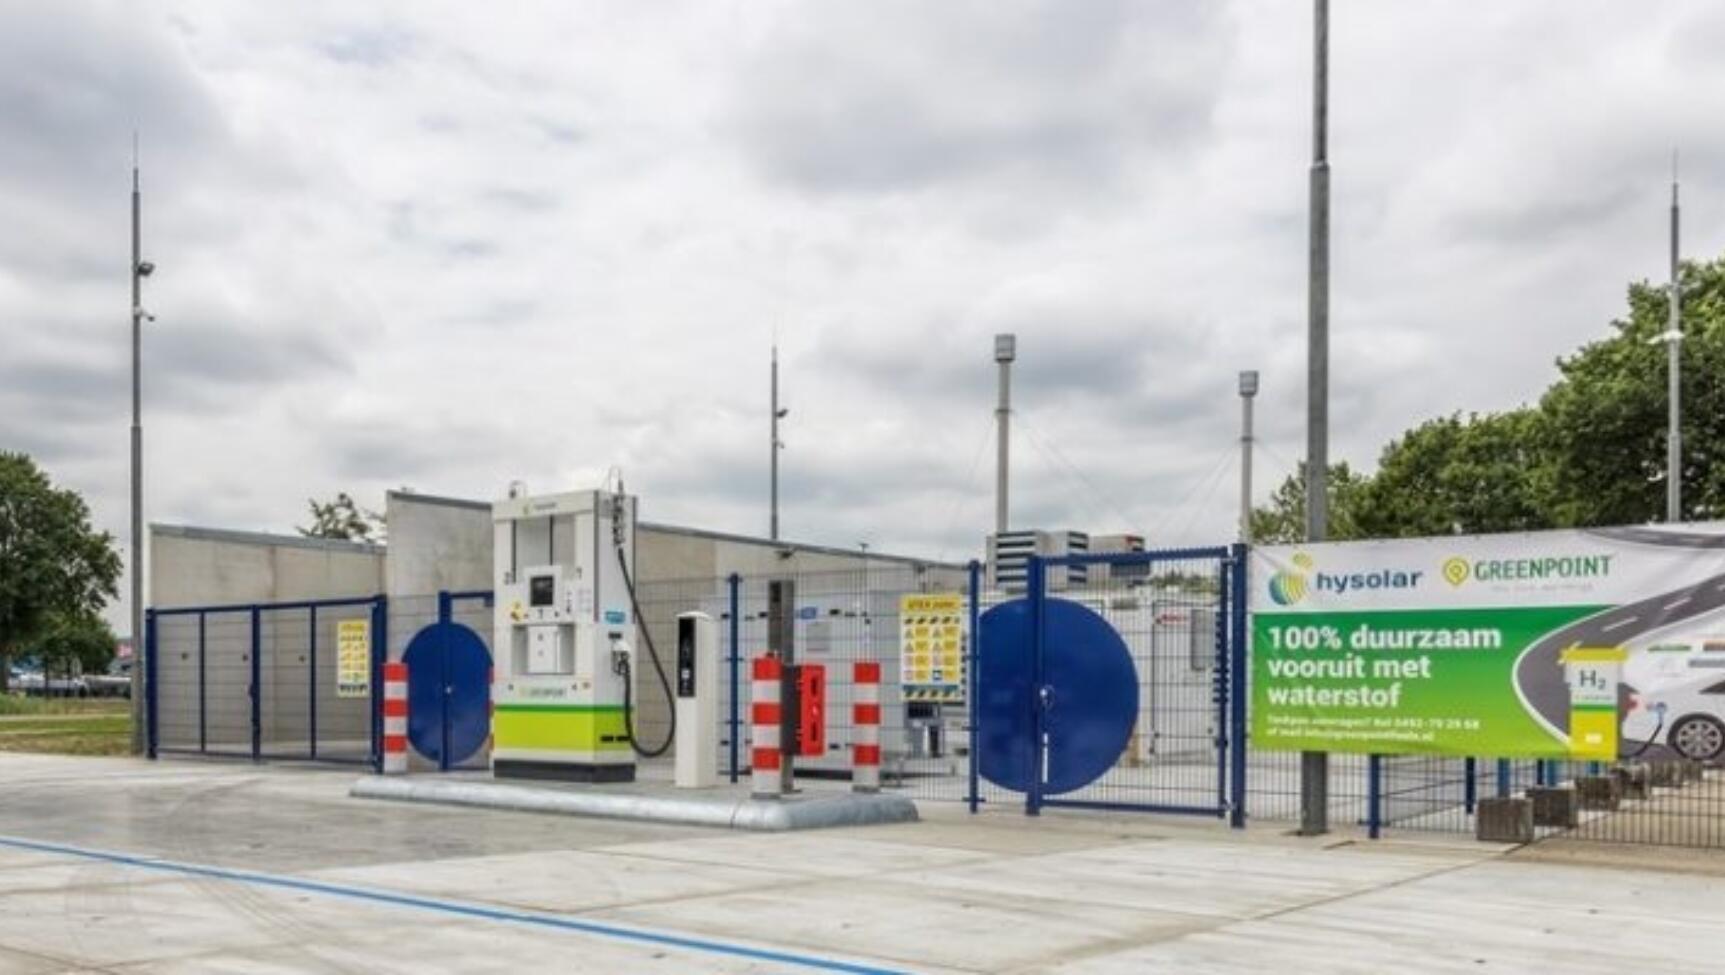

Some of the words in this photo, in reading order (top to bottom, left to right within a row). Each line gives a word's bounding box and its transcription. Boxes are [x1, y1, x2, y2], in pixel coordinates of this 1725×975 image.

[1317, 569, 1423, 593] hysolar
[1475, 555, 1611, 581] GREENPOINT
[1268, 626, 1342, 650] 100%
[1351, 623, 1502, 650] duurzaam
[1267, 652, 1366, 679] vooruit
[1373, 655, 1432, 679] met
[1267, 682, 1402, 708] waterstof
